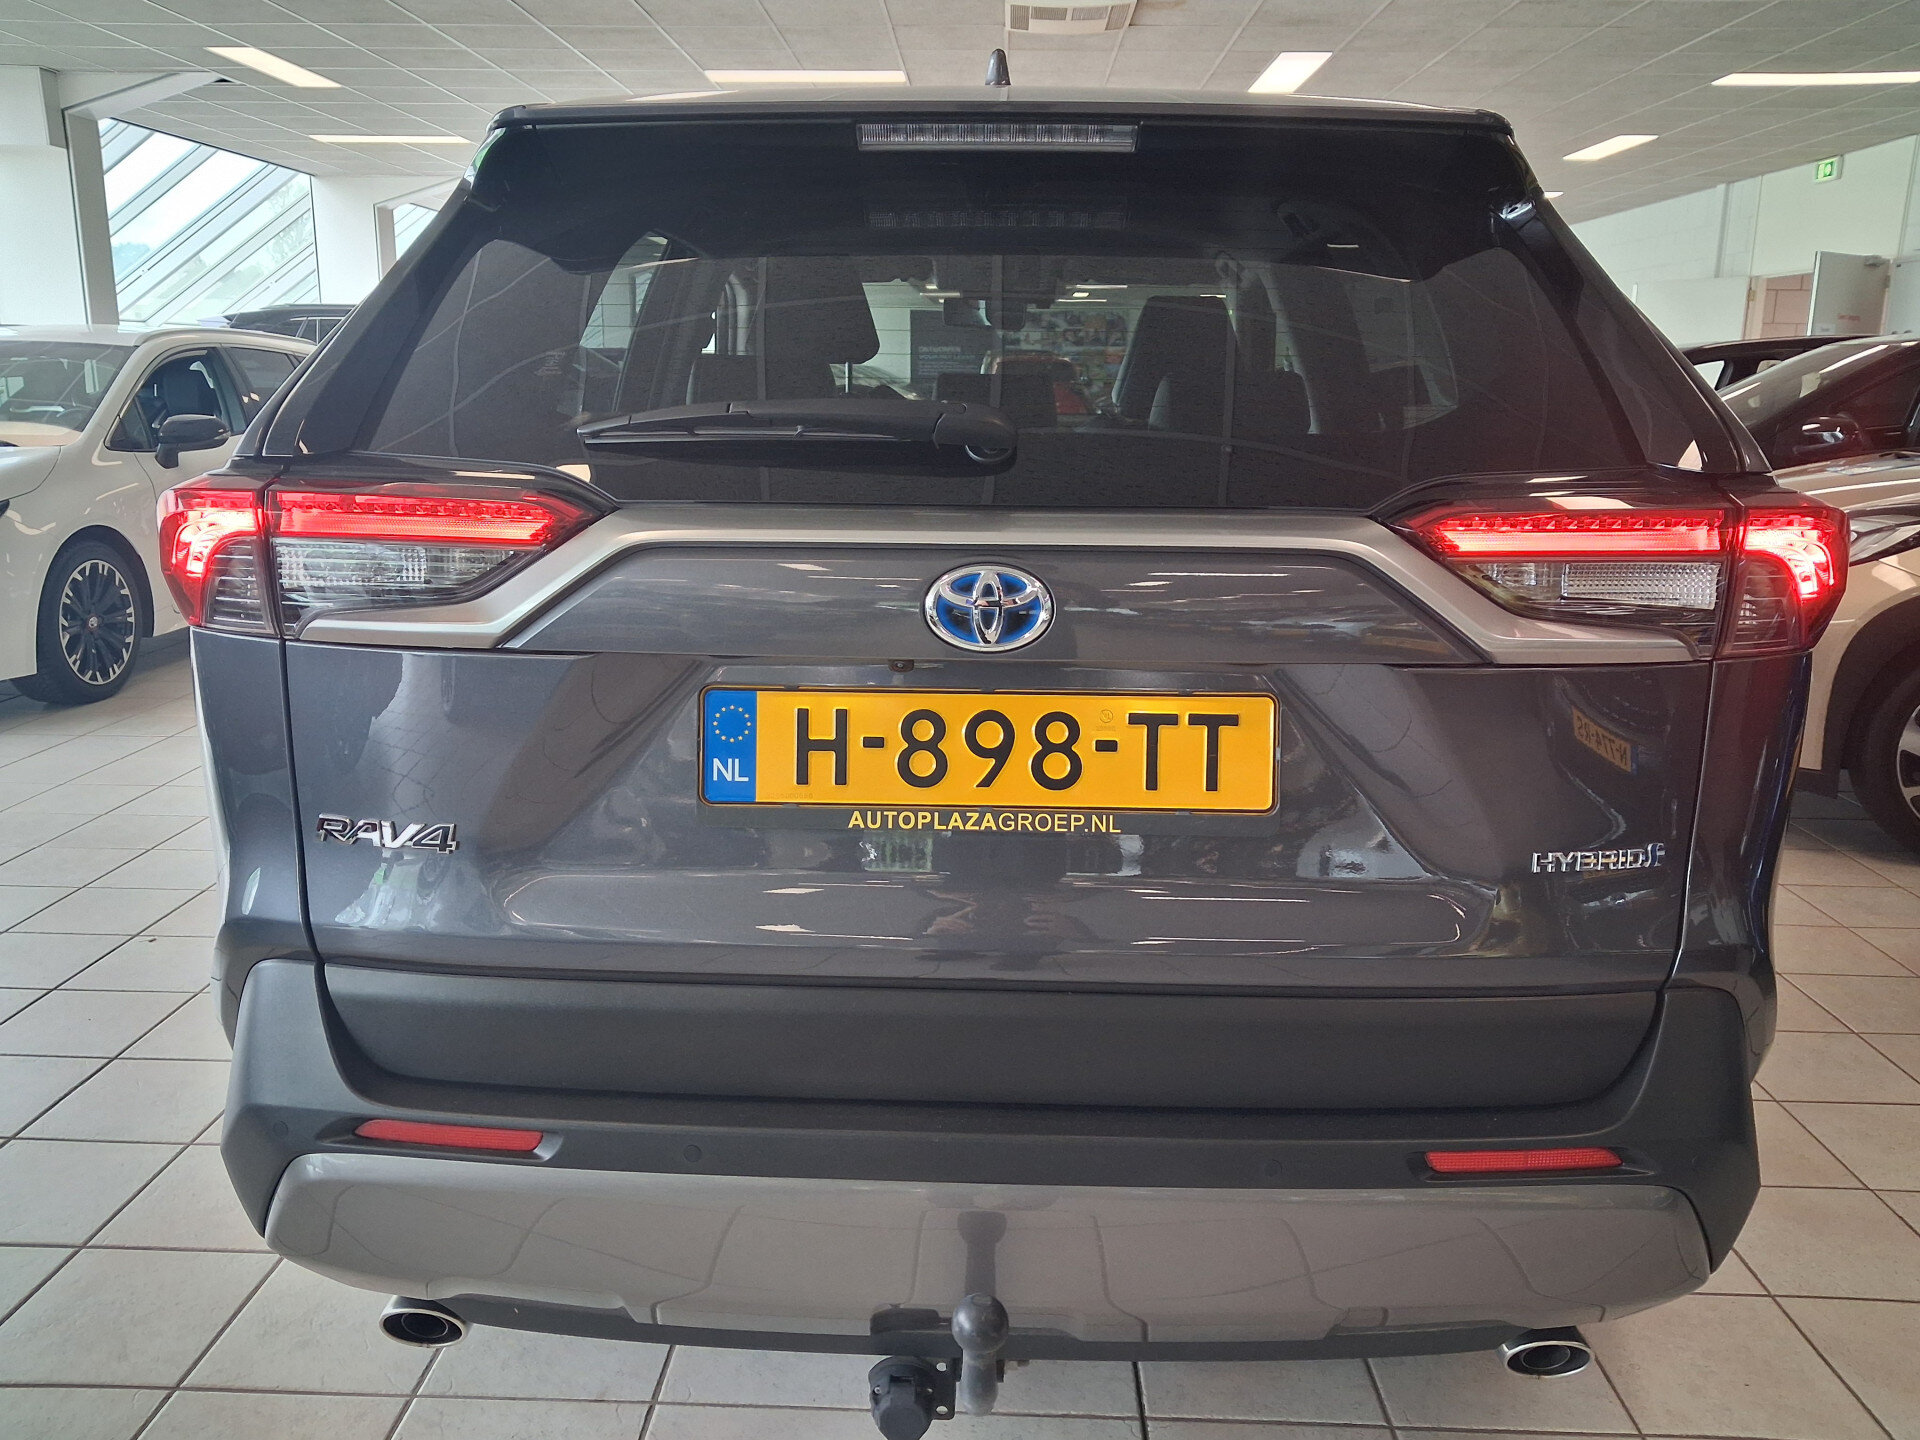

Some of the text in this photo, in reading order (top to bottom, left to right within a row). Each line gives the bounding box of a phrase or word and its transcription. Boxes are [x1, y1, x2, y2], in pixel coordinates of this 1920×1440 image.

[795, 707, 1240, 792] H-898-TT
[712, 758, 749, 782] NL
[316, 813, 458, 855] RAV4
[848, 810, 1122, 834] AUTOPLAZAGROEP.NL
[1531, 847, 1646, 873] HYBRID
